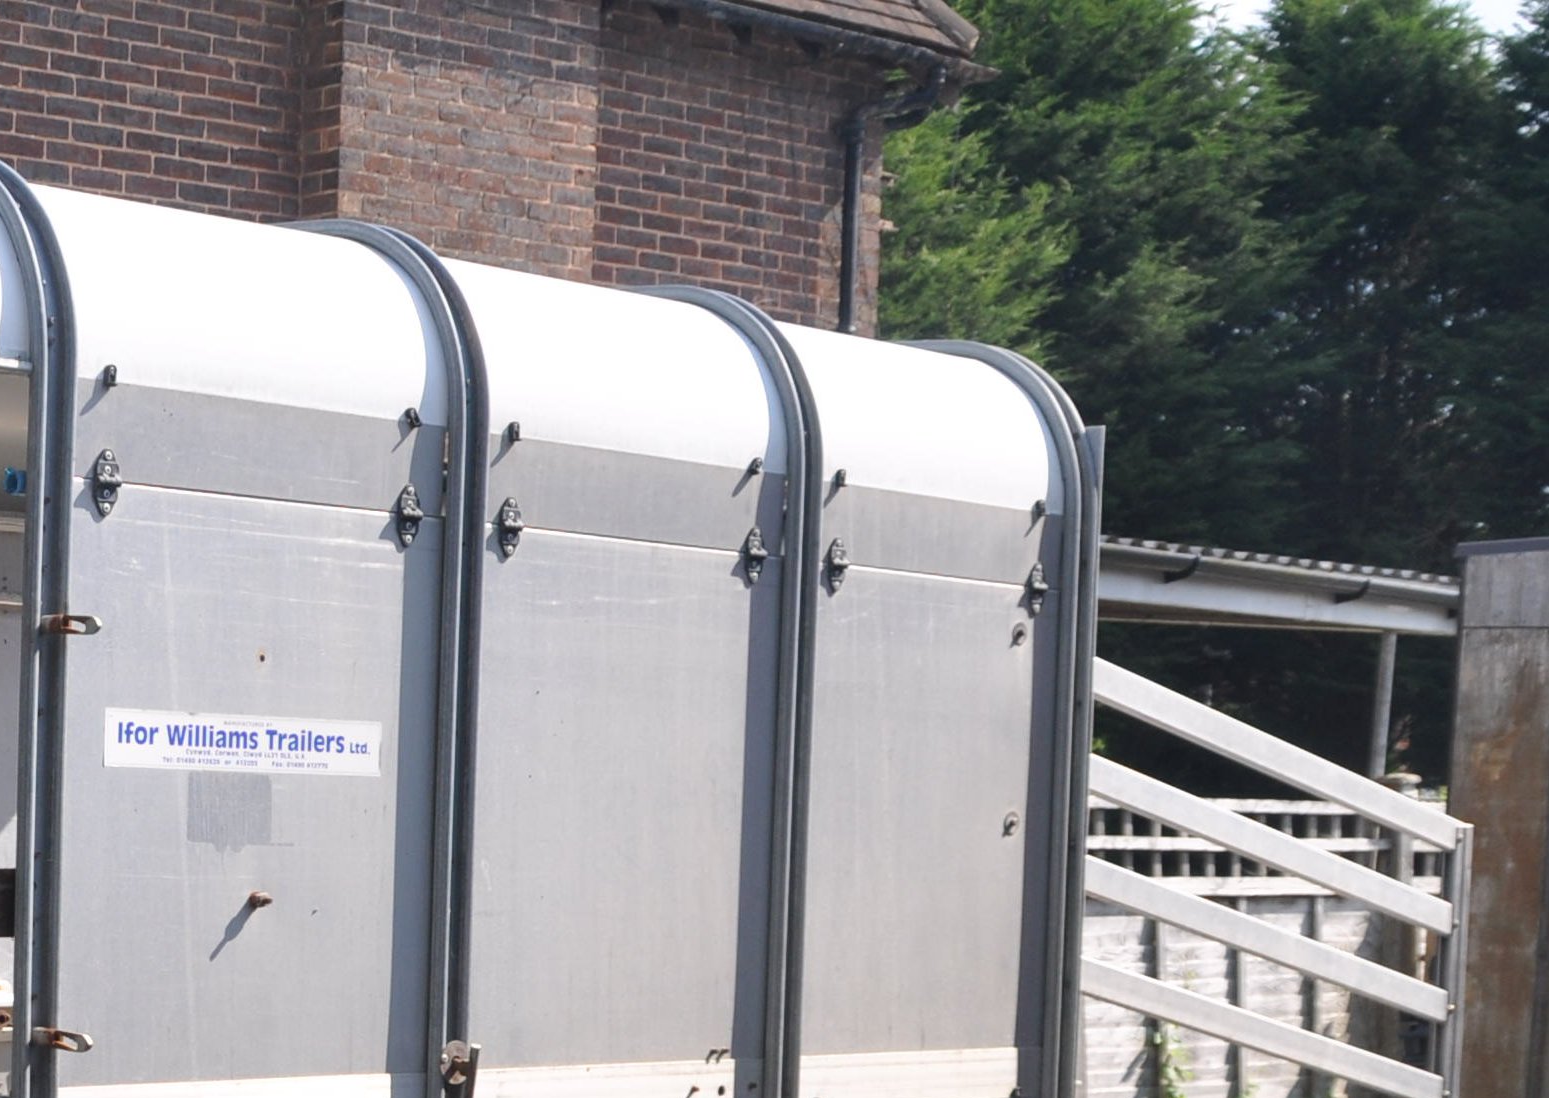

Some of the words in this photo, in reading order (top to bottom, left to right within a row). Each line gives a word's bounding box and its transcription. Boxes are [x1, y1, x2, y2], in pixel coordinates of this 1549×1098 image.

[117, 721, 159, 745] Ifor
[166, 723, 259, 750] Williams
[265, 729, 346, 754] Trailers
[349, 742, 371, 756] Ltd.
